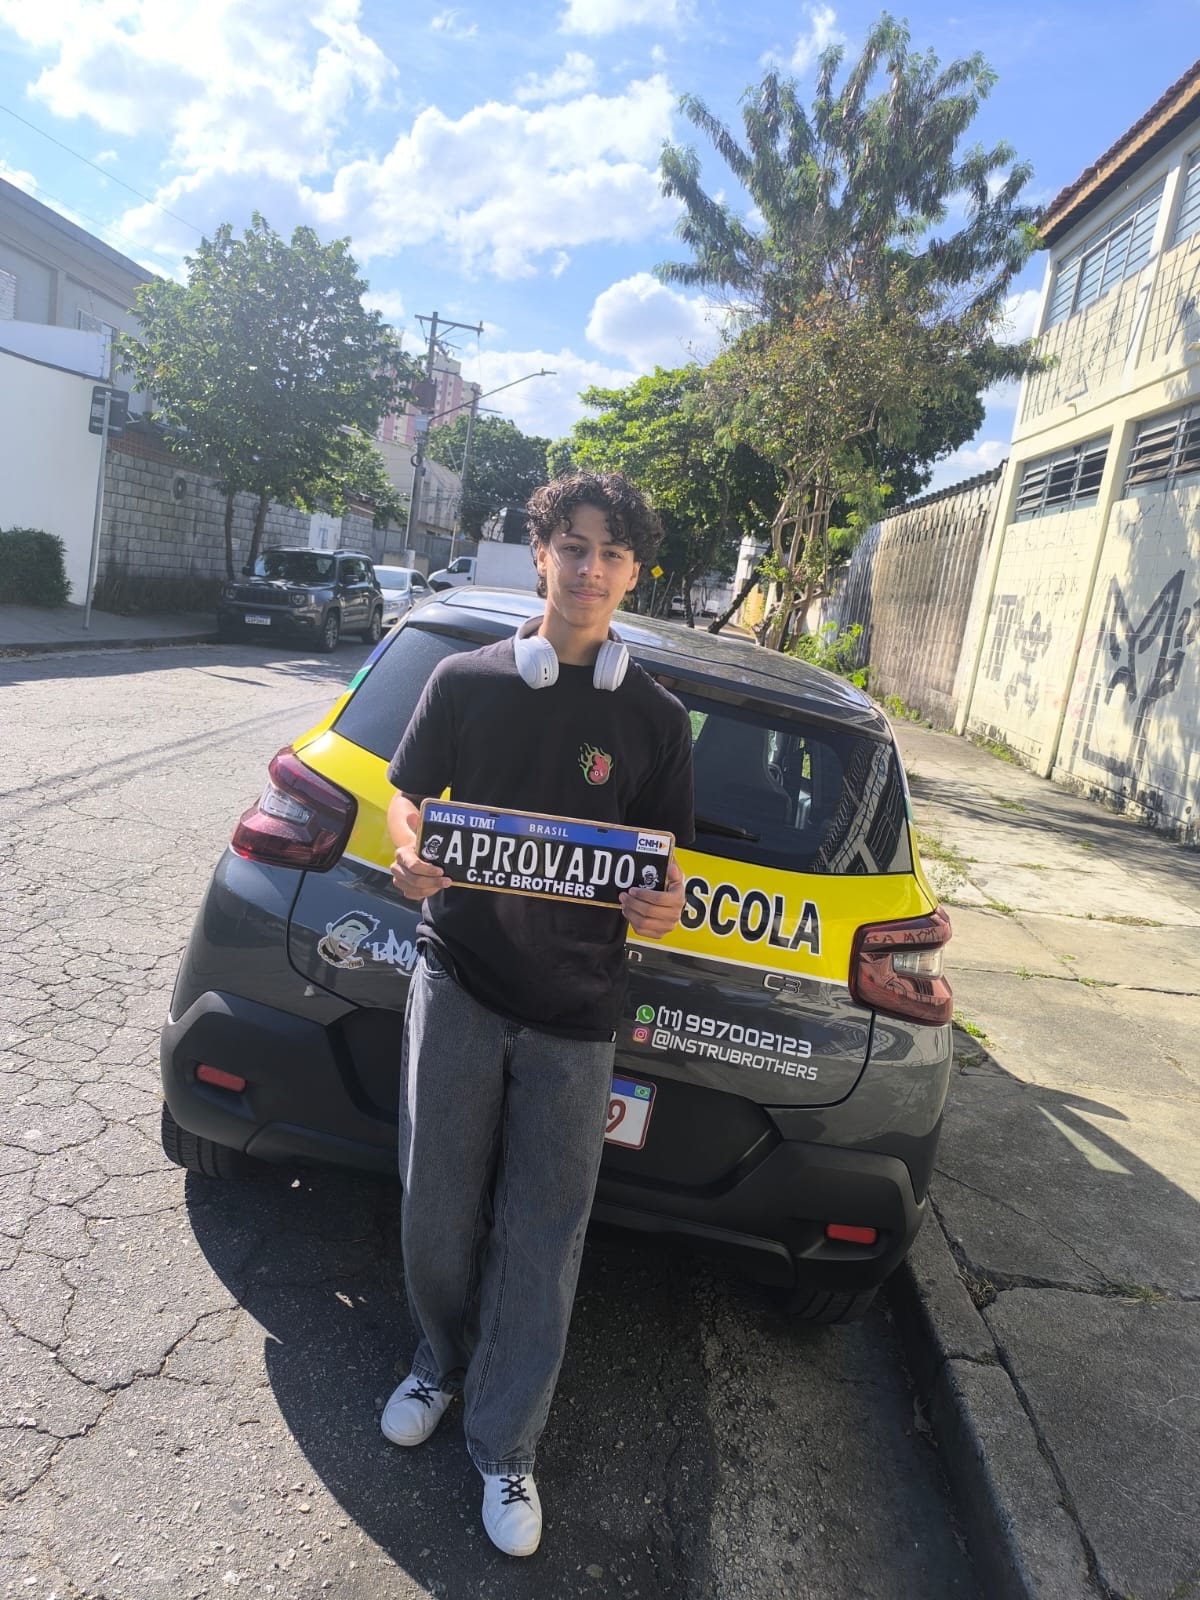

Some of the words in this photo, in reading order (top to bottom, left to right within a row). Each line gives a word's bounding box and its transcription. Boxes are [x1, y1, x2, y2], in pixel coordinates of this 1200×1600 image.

[430, 810, 465, 826] MAIS
[469, 816, 496, 830] UM!
[529, 823, 569, 838] BRASIL
[638, 838, 659, 848] CNH
[443, 830, 635, 889] APROVADO
[466, 868, 506, 885] C.T.C
[510, 874, 595, 898] BROTHERS
[680, 875, 821, 956] SCOLA
[763, 973, 801, 993] C3
[656, 1005, 683, 1031] (11)
[685, 1014, 812, 1059] 997002123
[651, 1028, 818, 1081] @INSTRUBROTHERS
